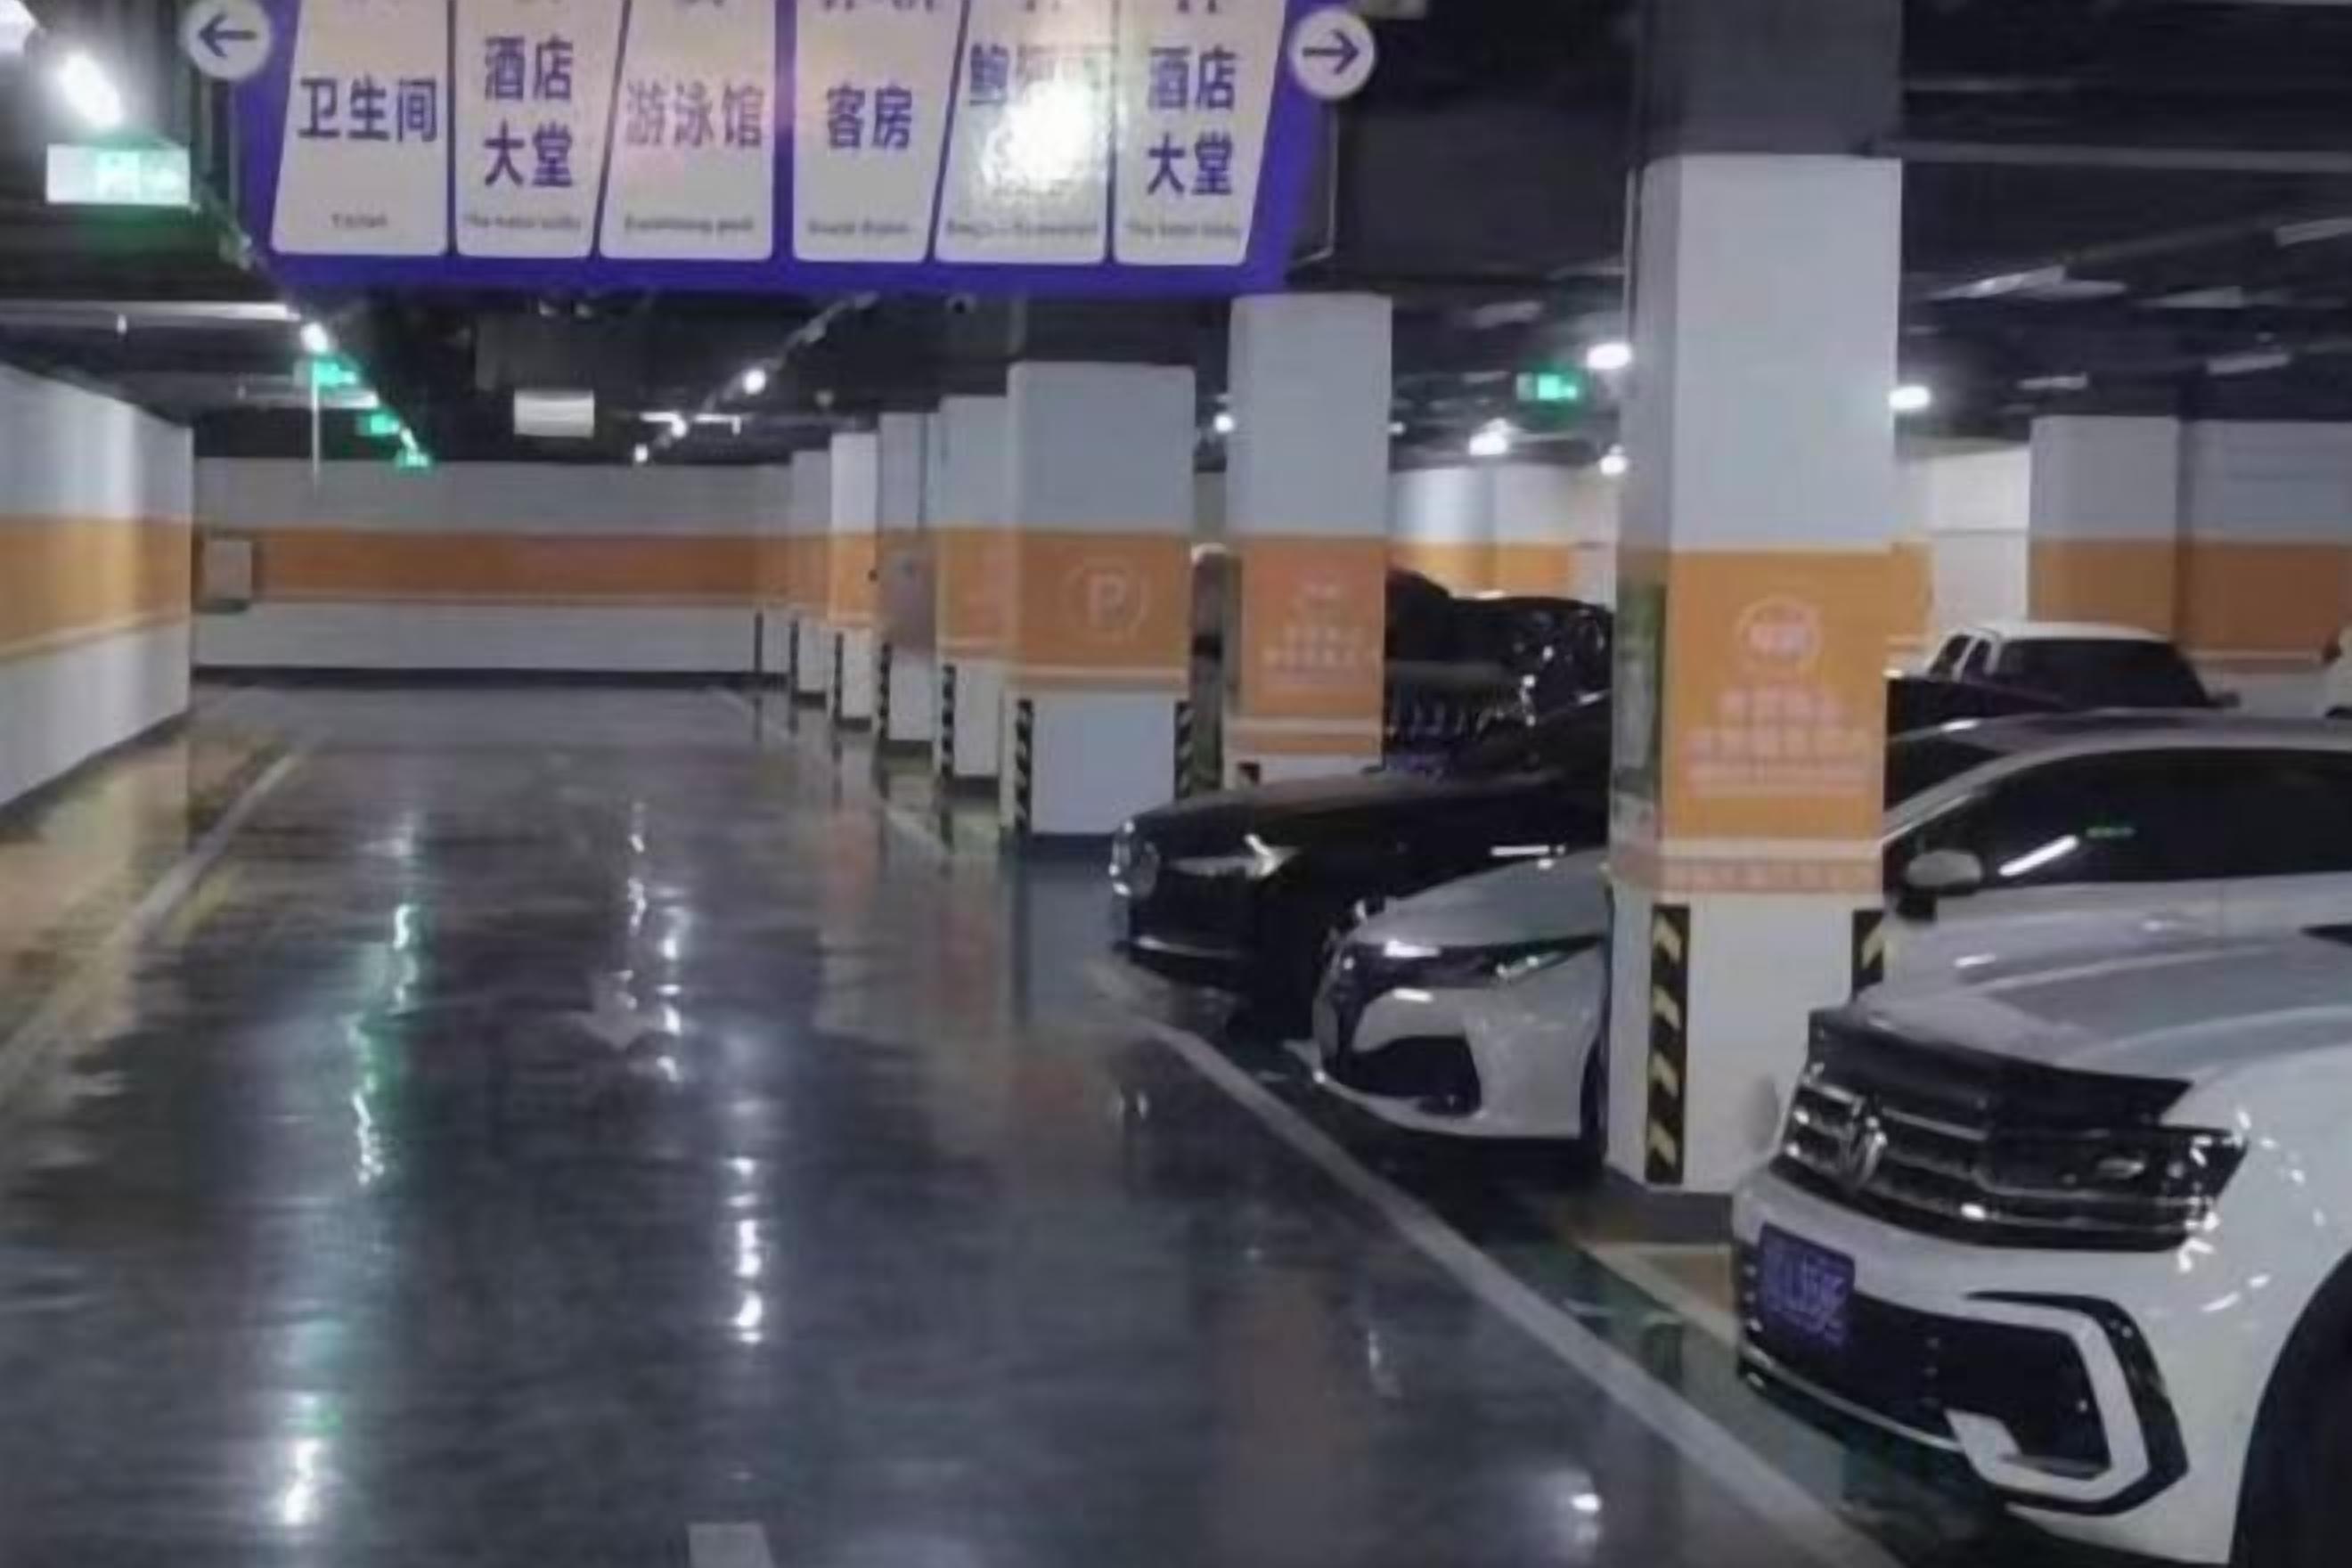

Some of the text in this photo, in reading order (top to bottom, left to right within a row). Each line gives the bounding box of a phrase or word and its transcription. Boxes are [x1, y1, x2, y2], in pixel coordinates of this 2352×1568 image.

[484, 34, 574, 102] 酒店
[1147, 45, 1237, 111] 酒店
[298, 74, 438, 143] 卫生间
[624, 81, 763, 149] 游泳馆
[826, 82, 913, 150] 客房
[484, 121, 574, 188] 大堂
[1146, 131, 1234, 197] 大堂
